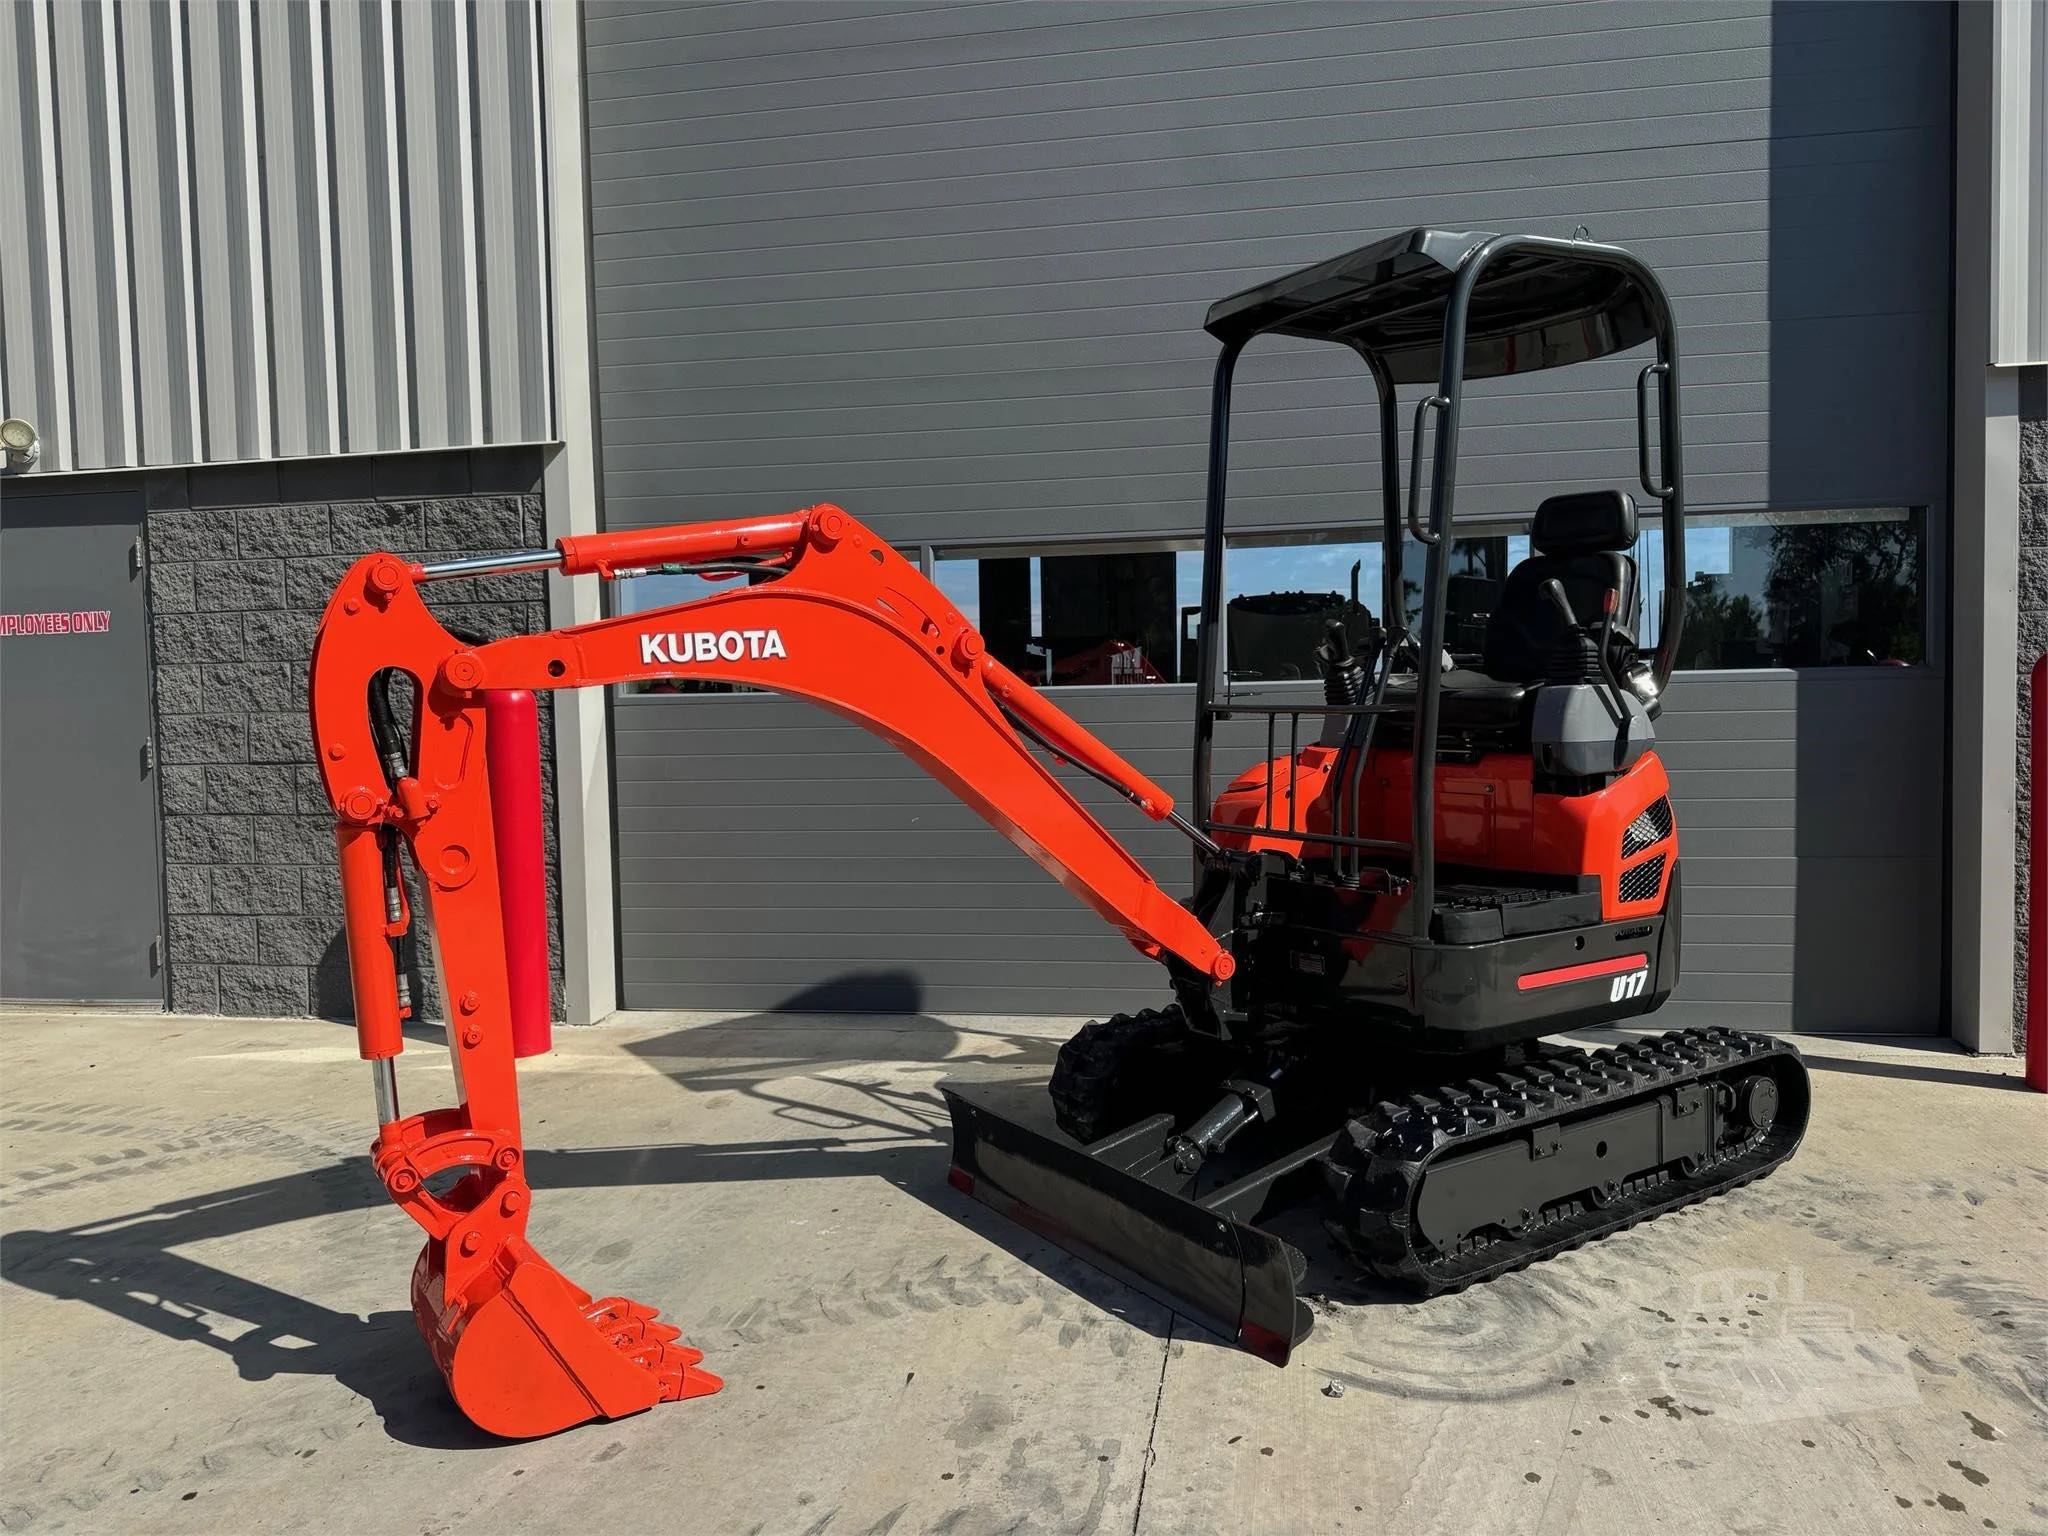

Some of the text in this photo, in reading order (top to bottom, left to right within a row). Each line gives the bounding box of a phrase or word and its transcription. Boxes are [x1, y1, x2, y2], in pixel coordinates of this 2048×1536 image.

[72, 610, 111, 633] ONLY
[640, 629, 787, 664] KUBOTA
[1610, 969, 1648, 1003] U17
